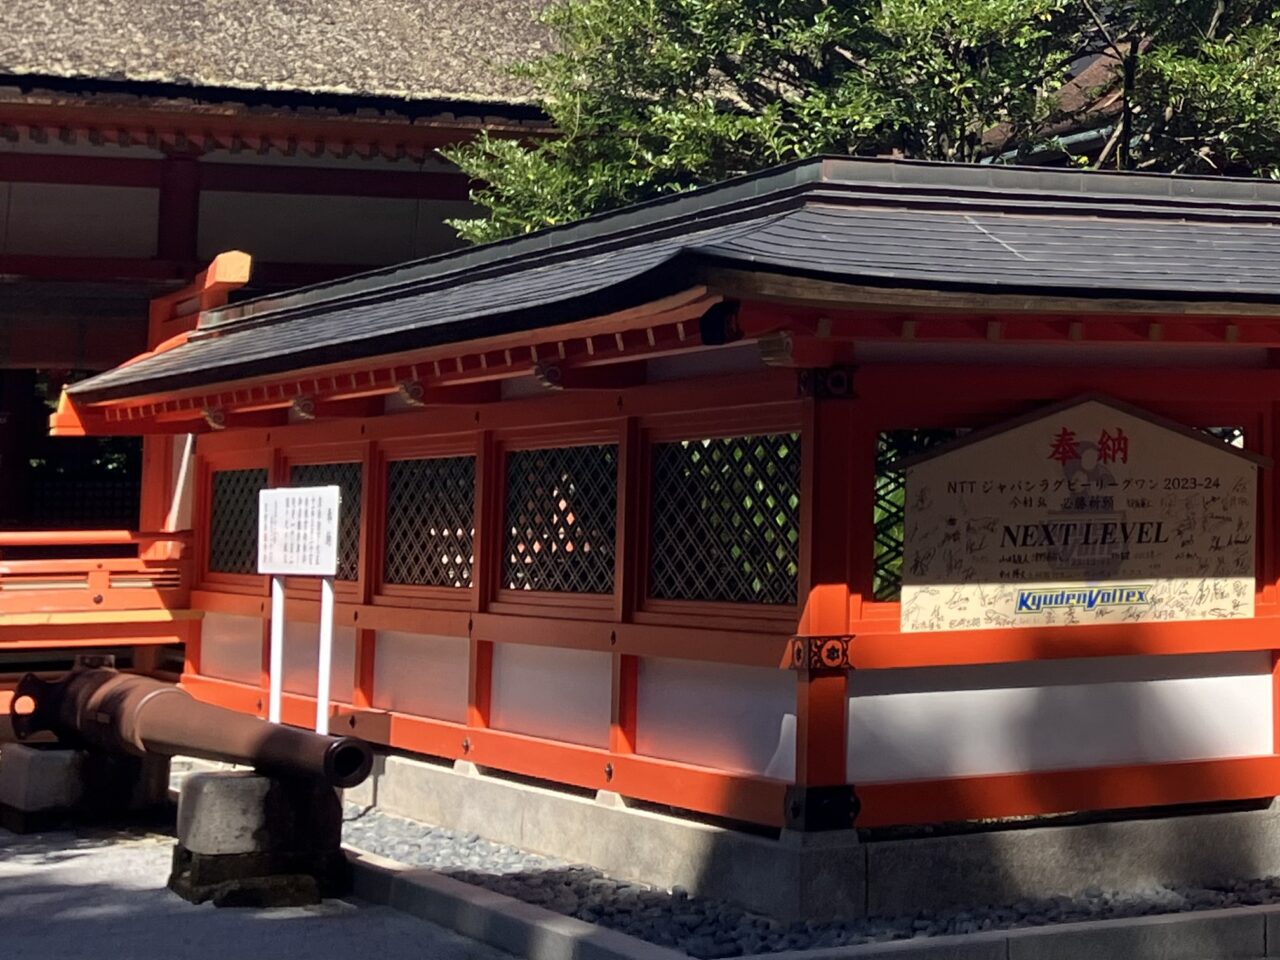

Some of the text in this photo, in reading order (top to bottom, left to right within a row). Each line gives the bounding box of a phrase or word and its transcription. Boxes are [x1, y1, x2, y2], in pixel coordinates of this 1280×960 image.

[1048, 428, 1128, 465] 奉納
[948, 478, 1221, 494] NTT ジャパンラグビーリーグワン 2023-24
[1001, 521, 1169, 548] NEXT LEVEL
